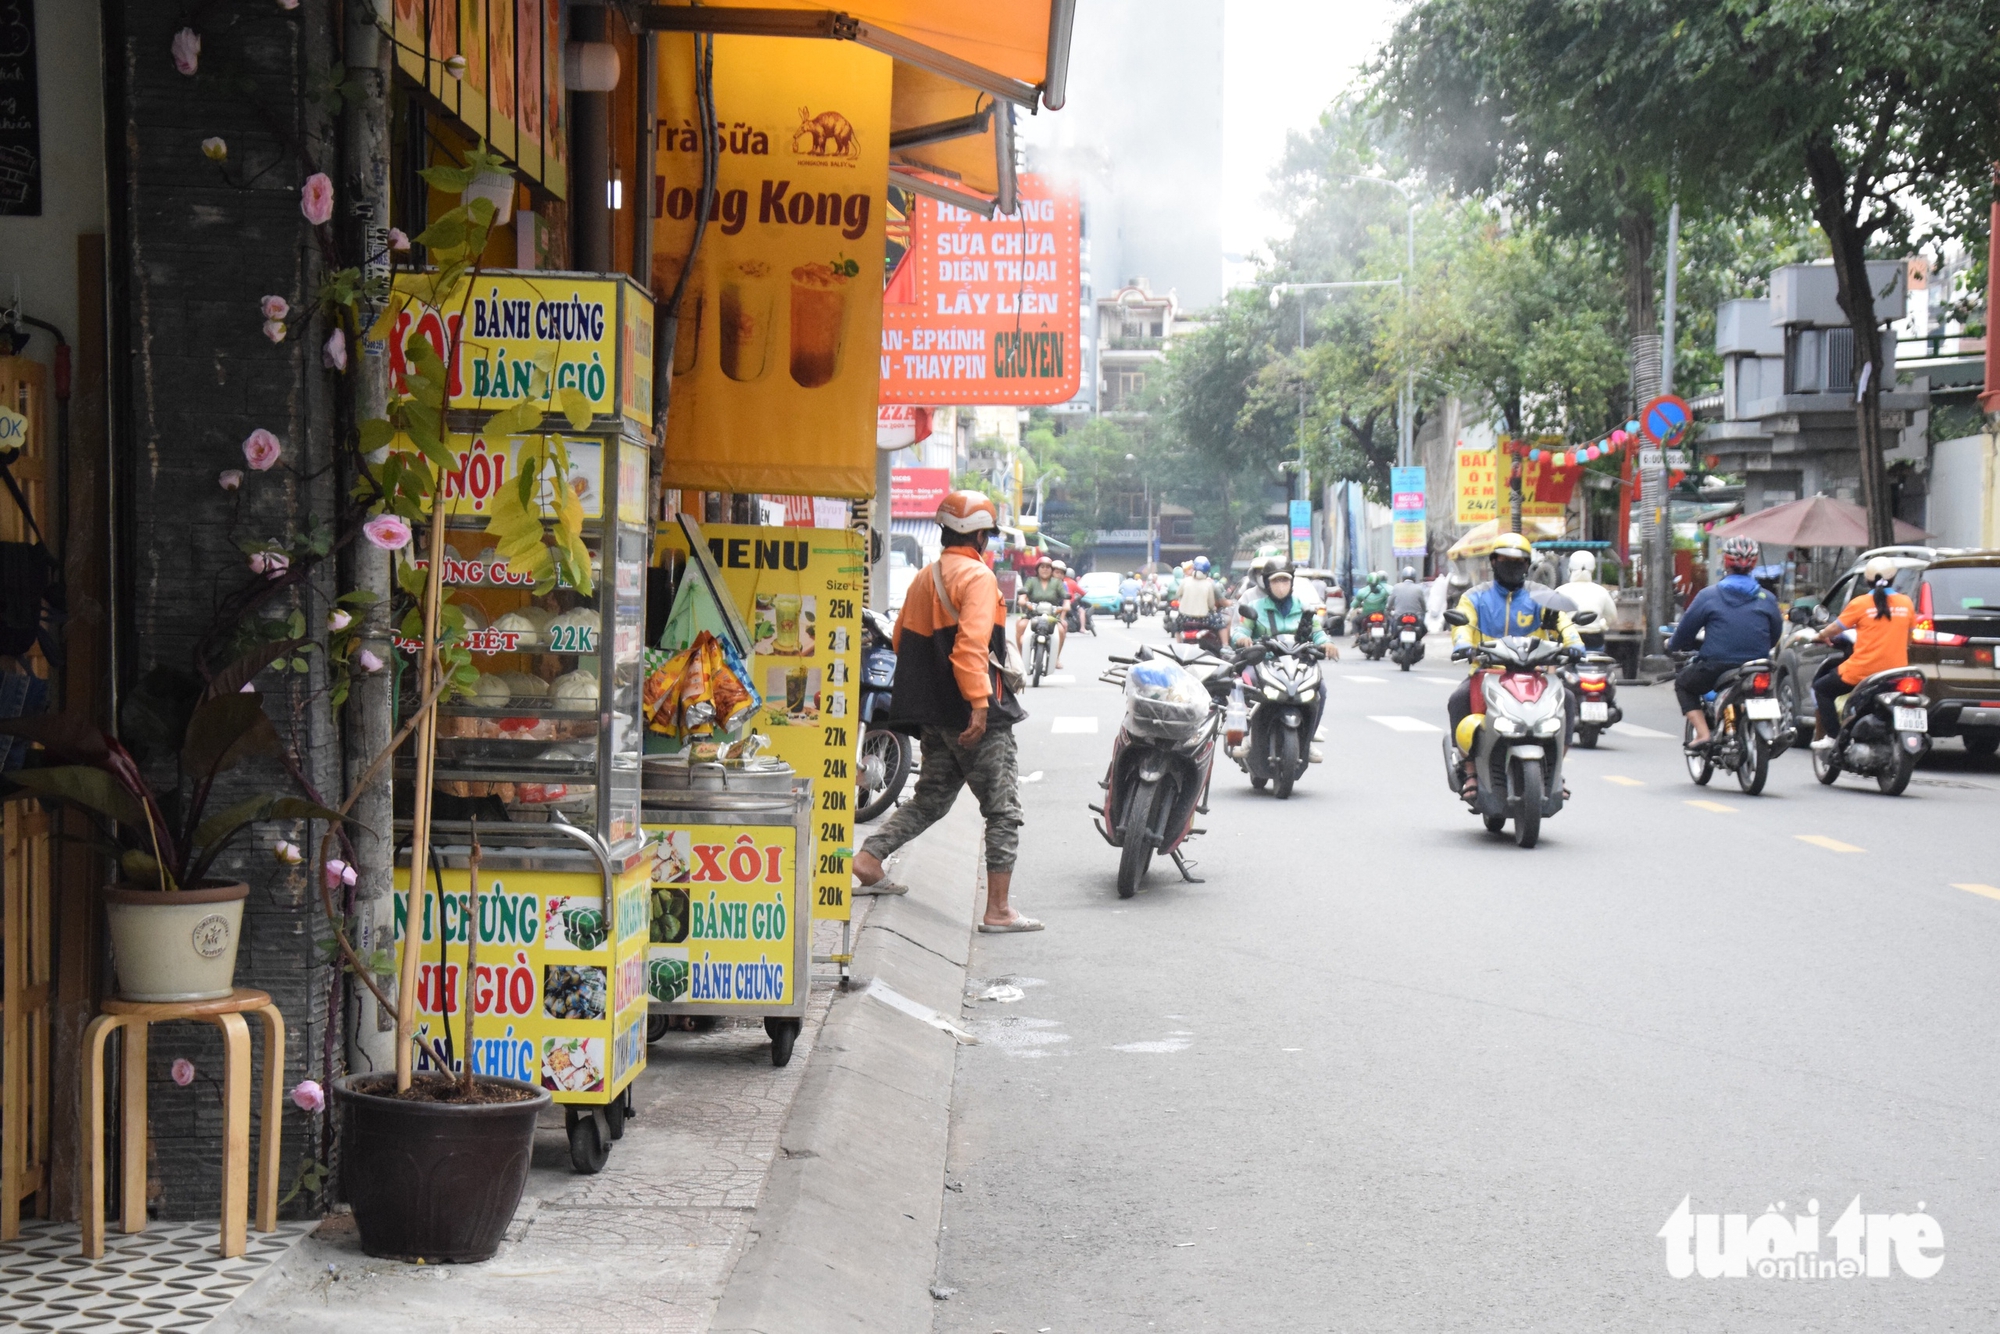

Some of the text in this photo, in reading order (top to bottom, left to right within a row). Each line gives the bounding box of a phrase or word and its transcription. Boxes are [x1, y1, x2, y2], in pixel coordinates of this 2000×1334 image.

[716, 122, 769, 156] Sữa
[759, 179, 870, 241] Kong
[991, 228, 1056, 255] CHỮA
[994, 260, 1057, 286] THOẠI
[474, 288, 531, 338] BÁNH
[994, 321, 1063, 378] CHUYÊN
[0, 416, 22, 439] OK
[706, 538, 809, 571] MENU
[826, 579, 849, 591] Size
[829, 599, 853, 618] 25k
[551, 626, 593, 650] 22K
[824, 727, 847, 746] 27k
[823, 759, 847, 778] 24k
[822, 790, 847, 810] 20k
[821, 823, 845, 842] 24k
[692, 834, 783, 882] XÔI
[820, 854, 844, 874] 20k
[819, 886, 843, 906] 20k
[692, 891, 748, 939] BÁNH
[752, 892, 786, 940] GIÒ
[473, 952, 534, 1014] GIÒ
[692, 951, 732, 999] BÁNH
[735, 954, 784, 1000] CHƯNG
